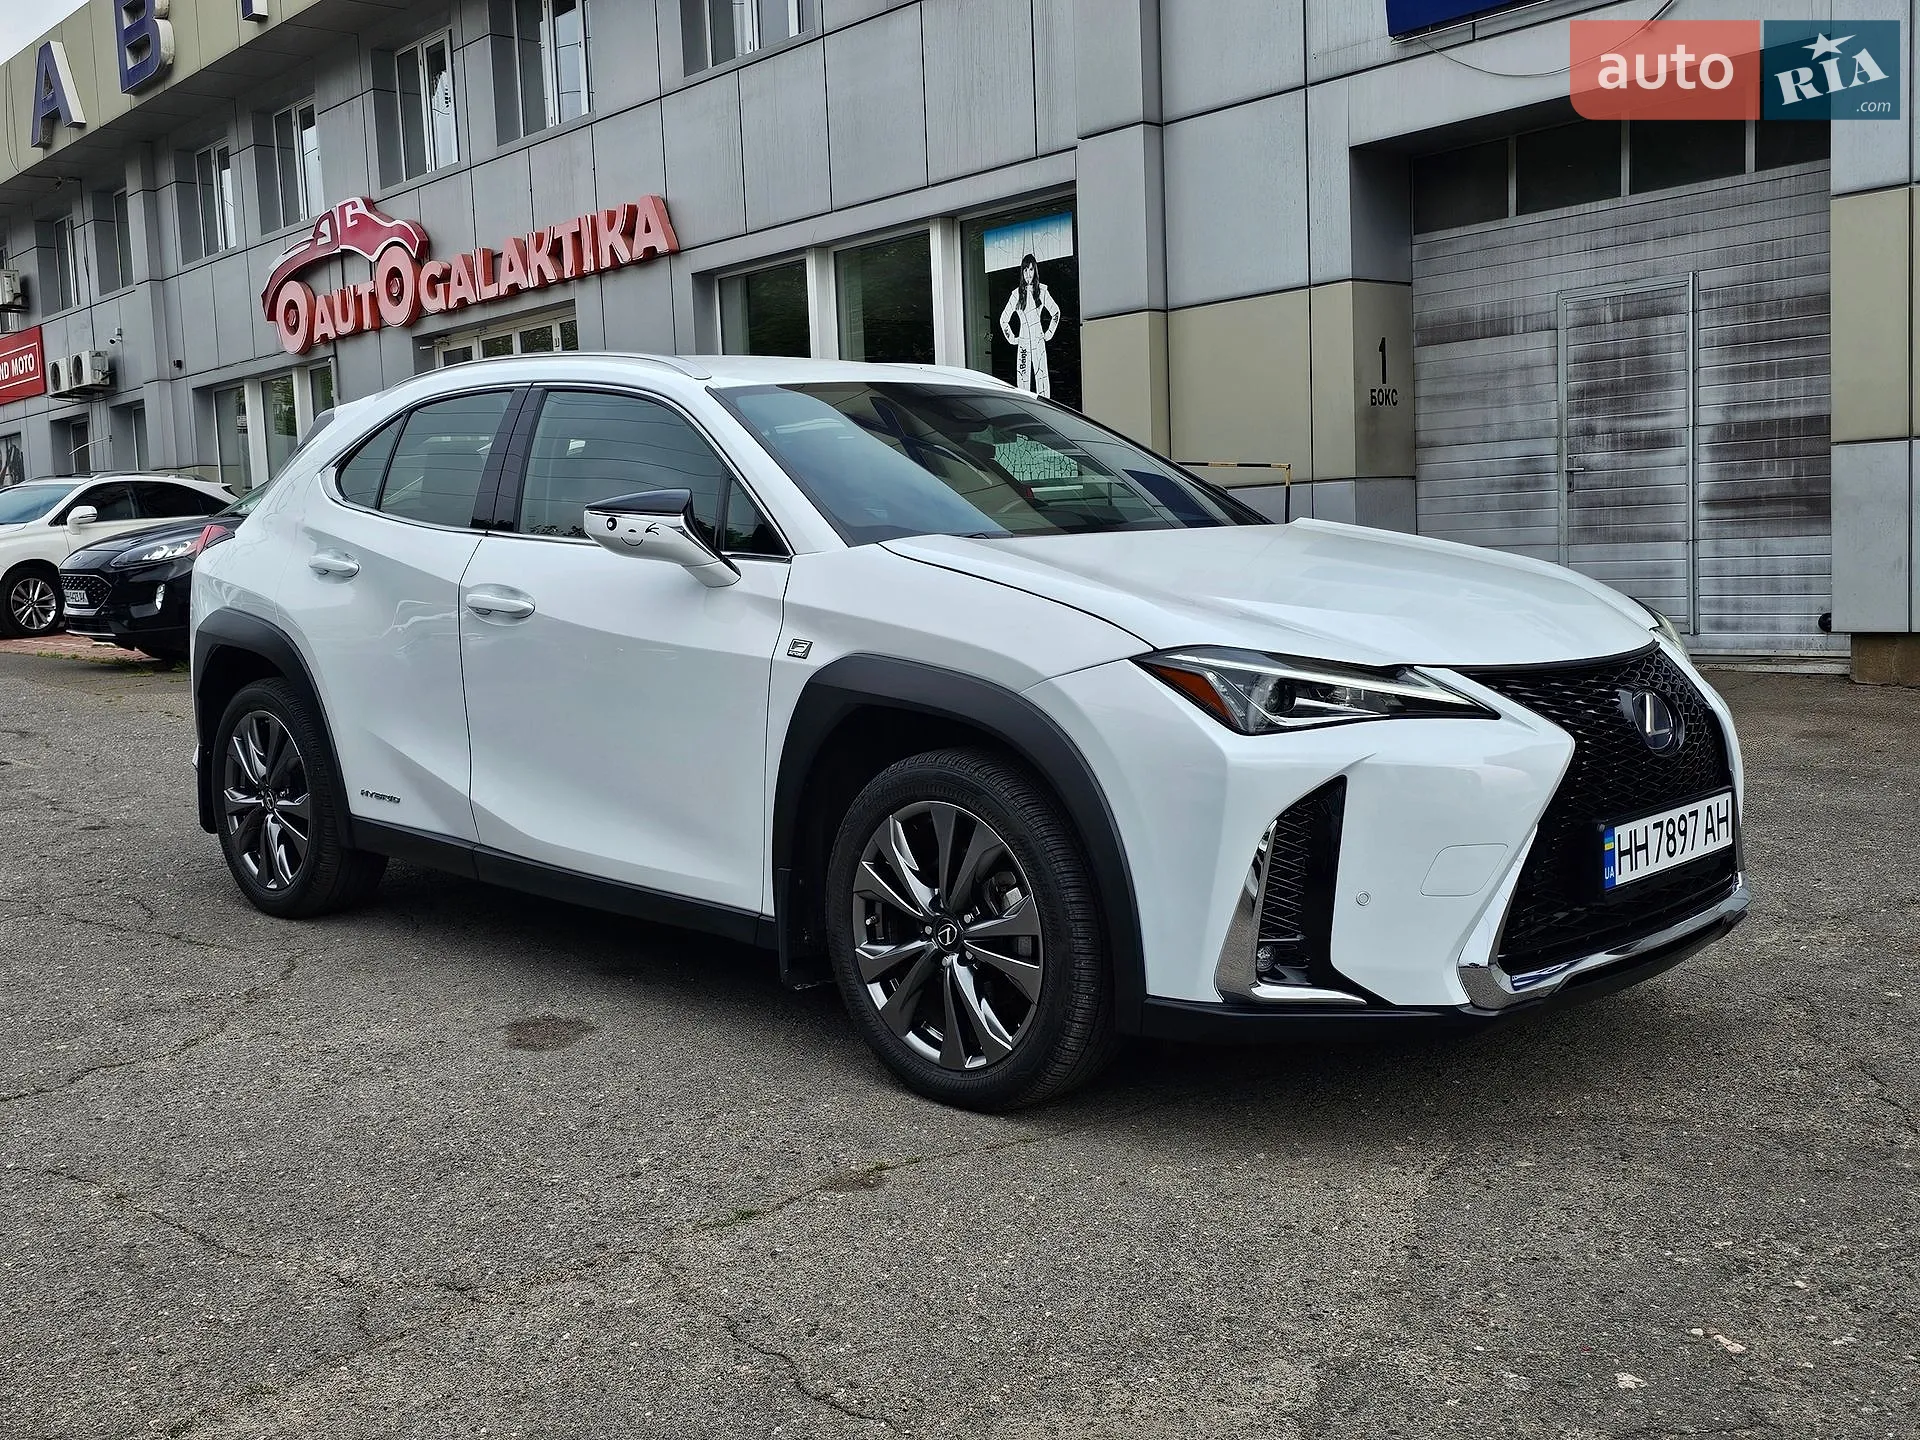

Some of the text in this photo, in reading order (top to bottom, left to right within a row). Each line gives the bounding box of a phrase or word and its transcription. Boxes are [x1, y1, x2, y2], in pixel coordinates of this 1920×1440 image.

[11, 353, 35, 377] MOTO
[1378, 337, 1387, 384] 1
[1370, 388, 1398, 406] БОКС
[1617, 799, 1730, 876] HH 7897 AH
[1604, 866, 1615, 880] UA
